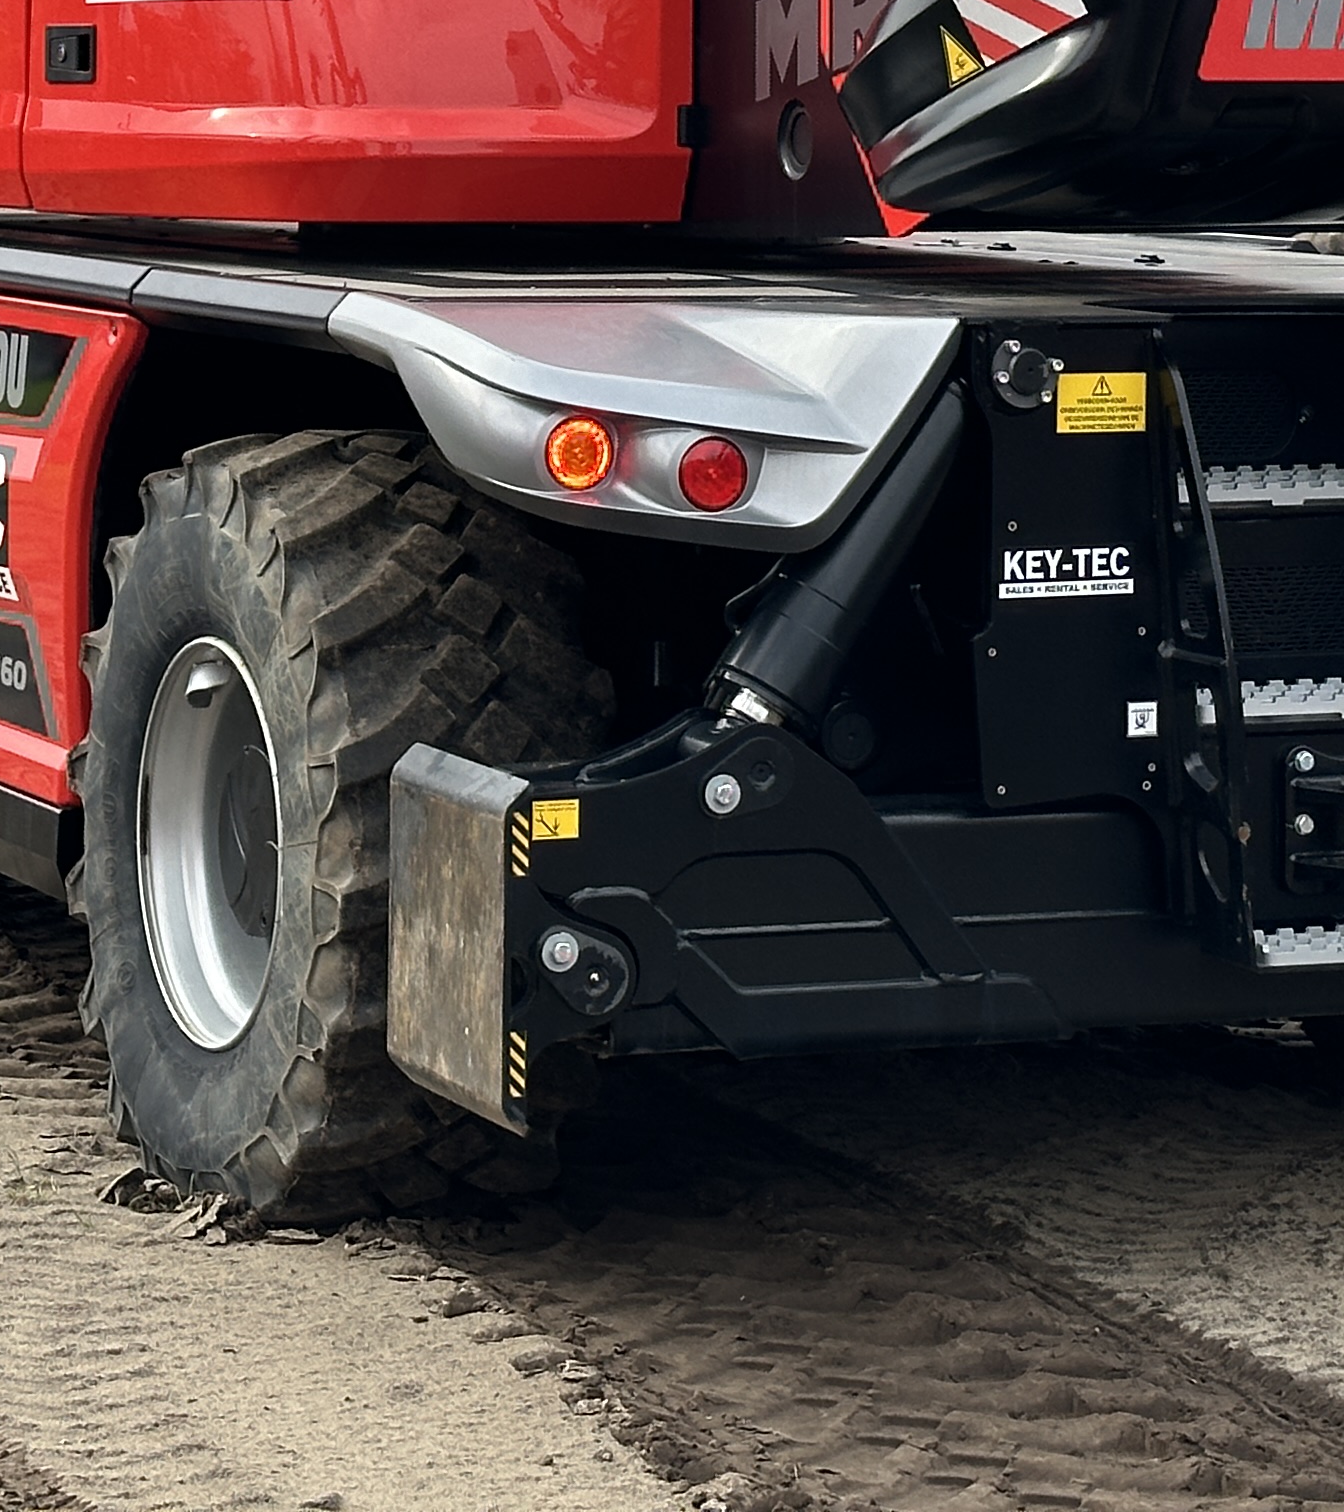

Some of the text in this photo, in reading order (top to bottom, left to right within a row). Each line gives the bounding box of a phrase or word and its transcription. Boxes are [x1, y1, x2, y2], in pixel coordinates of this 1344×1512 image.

[1003, 546, 1131, 581] KEY-TEC
[1005, 582, 1130, 595] SALES RENTAL SERVICE
